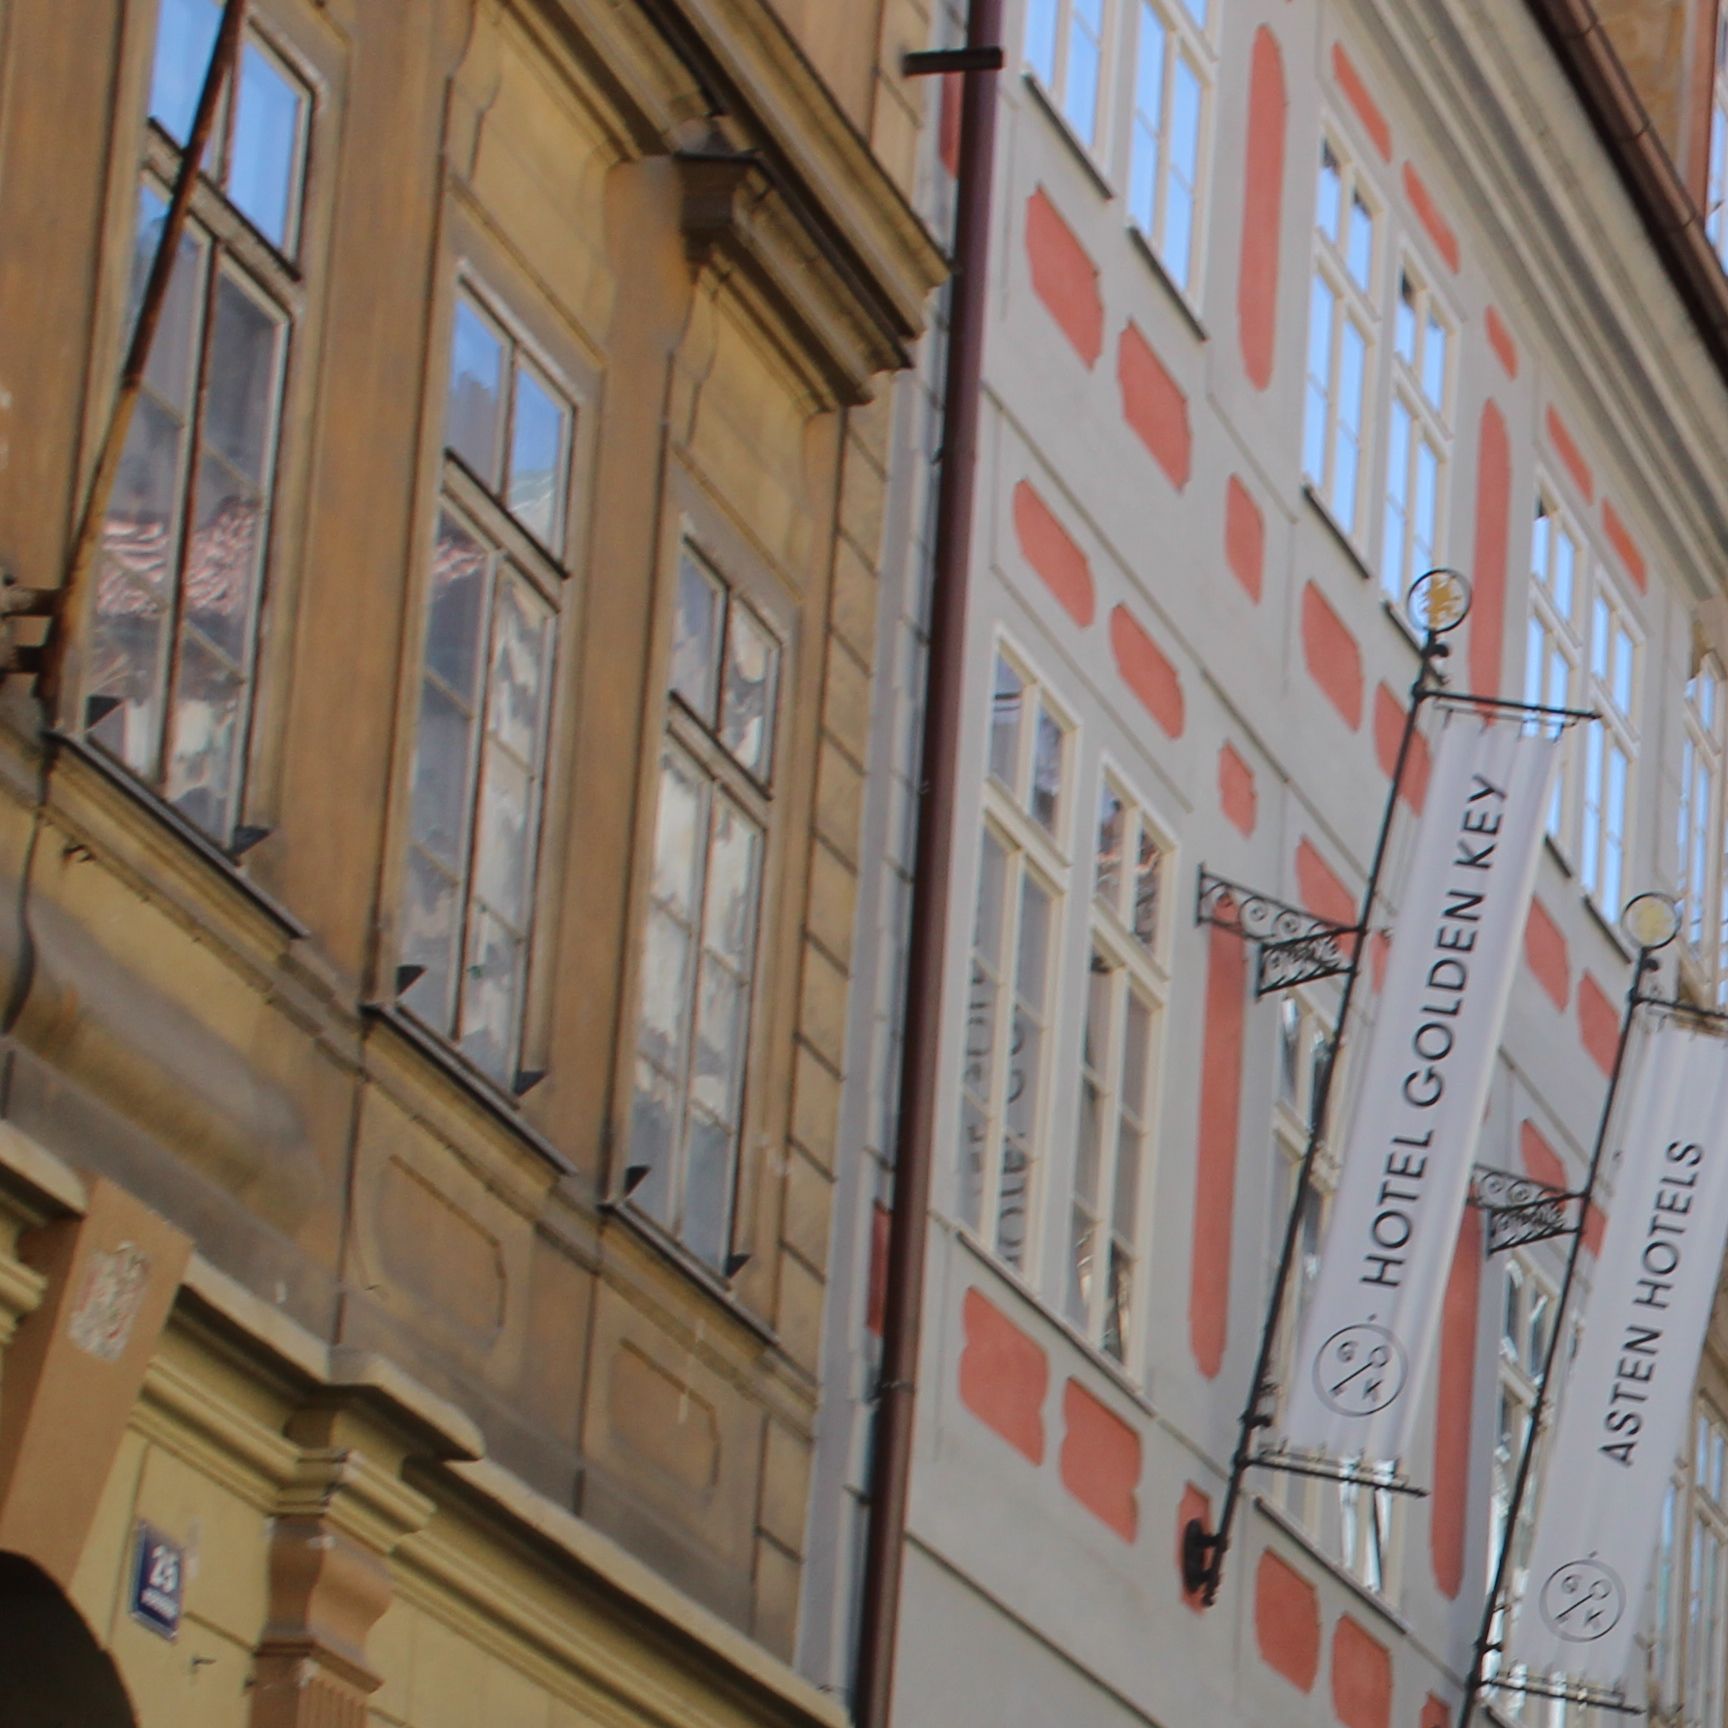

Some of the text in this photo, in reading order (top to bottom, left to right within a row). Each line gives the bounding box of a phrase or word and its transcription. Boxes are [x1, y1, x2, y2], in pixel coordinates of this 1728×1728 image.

[1360, 773, 1508, 1289] HOTEL GOLDEN KEY
[1599, 1138, 1705, 1468] ASTEN HOTELS
[149, 1544, 180, 1593] 25
